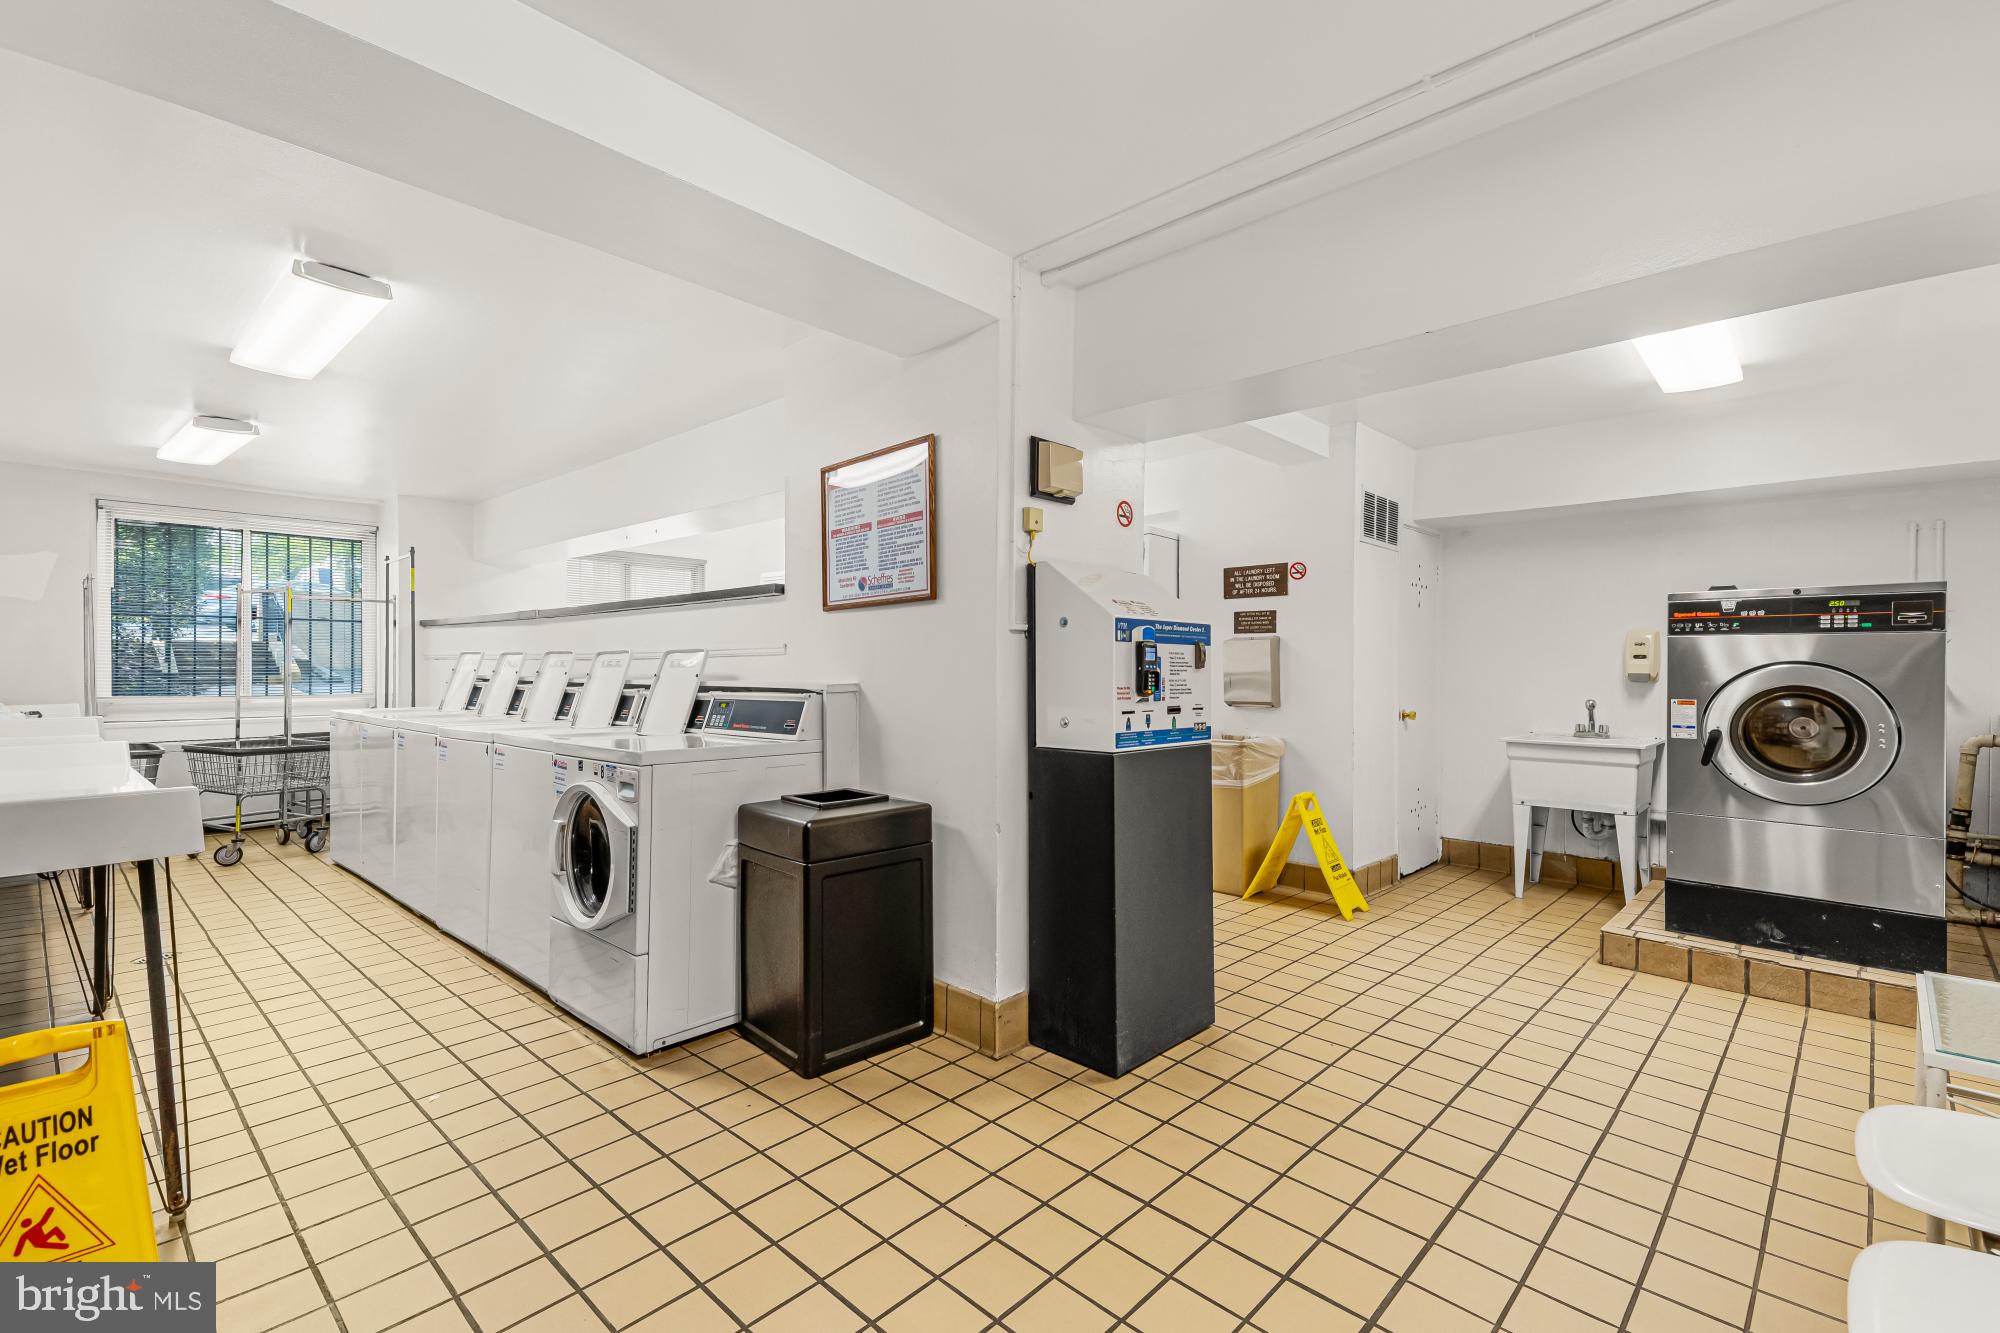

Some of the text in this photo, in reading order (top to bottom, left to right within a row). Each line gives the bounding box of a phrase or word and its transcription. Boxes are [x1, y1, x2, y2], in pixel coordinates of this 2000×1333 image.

[1252, 580, 1275, 588] DISPOSED
[0, 1105, 93, 1150] AUTION
[0, 1134, 100, 1176] et Floor
